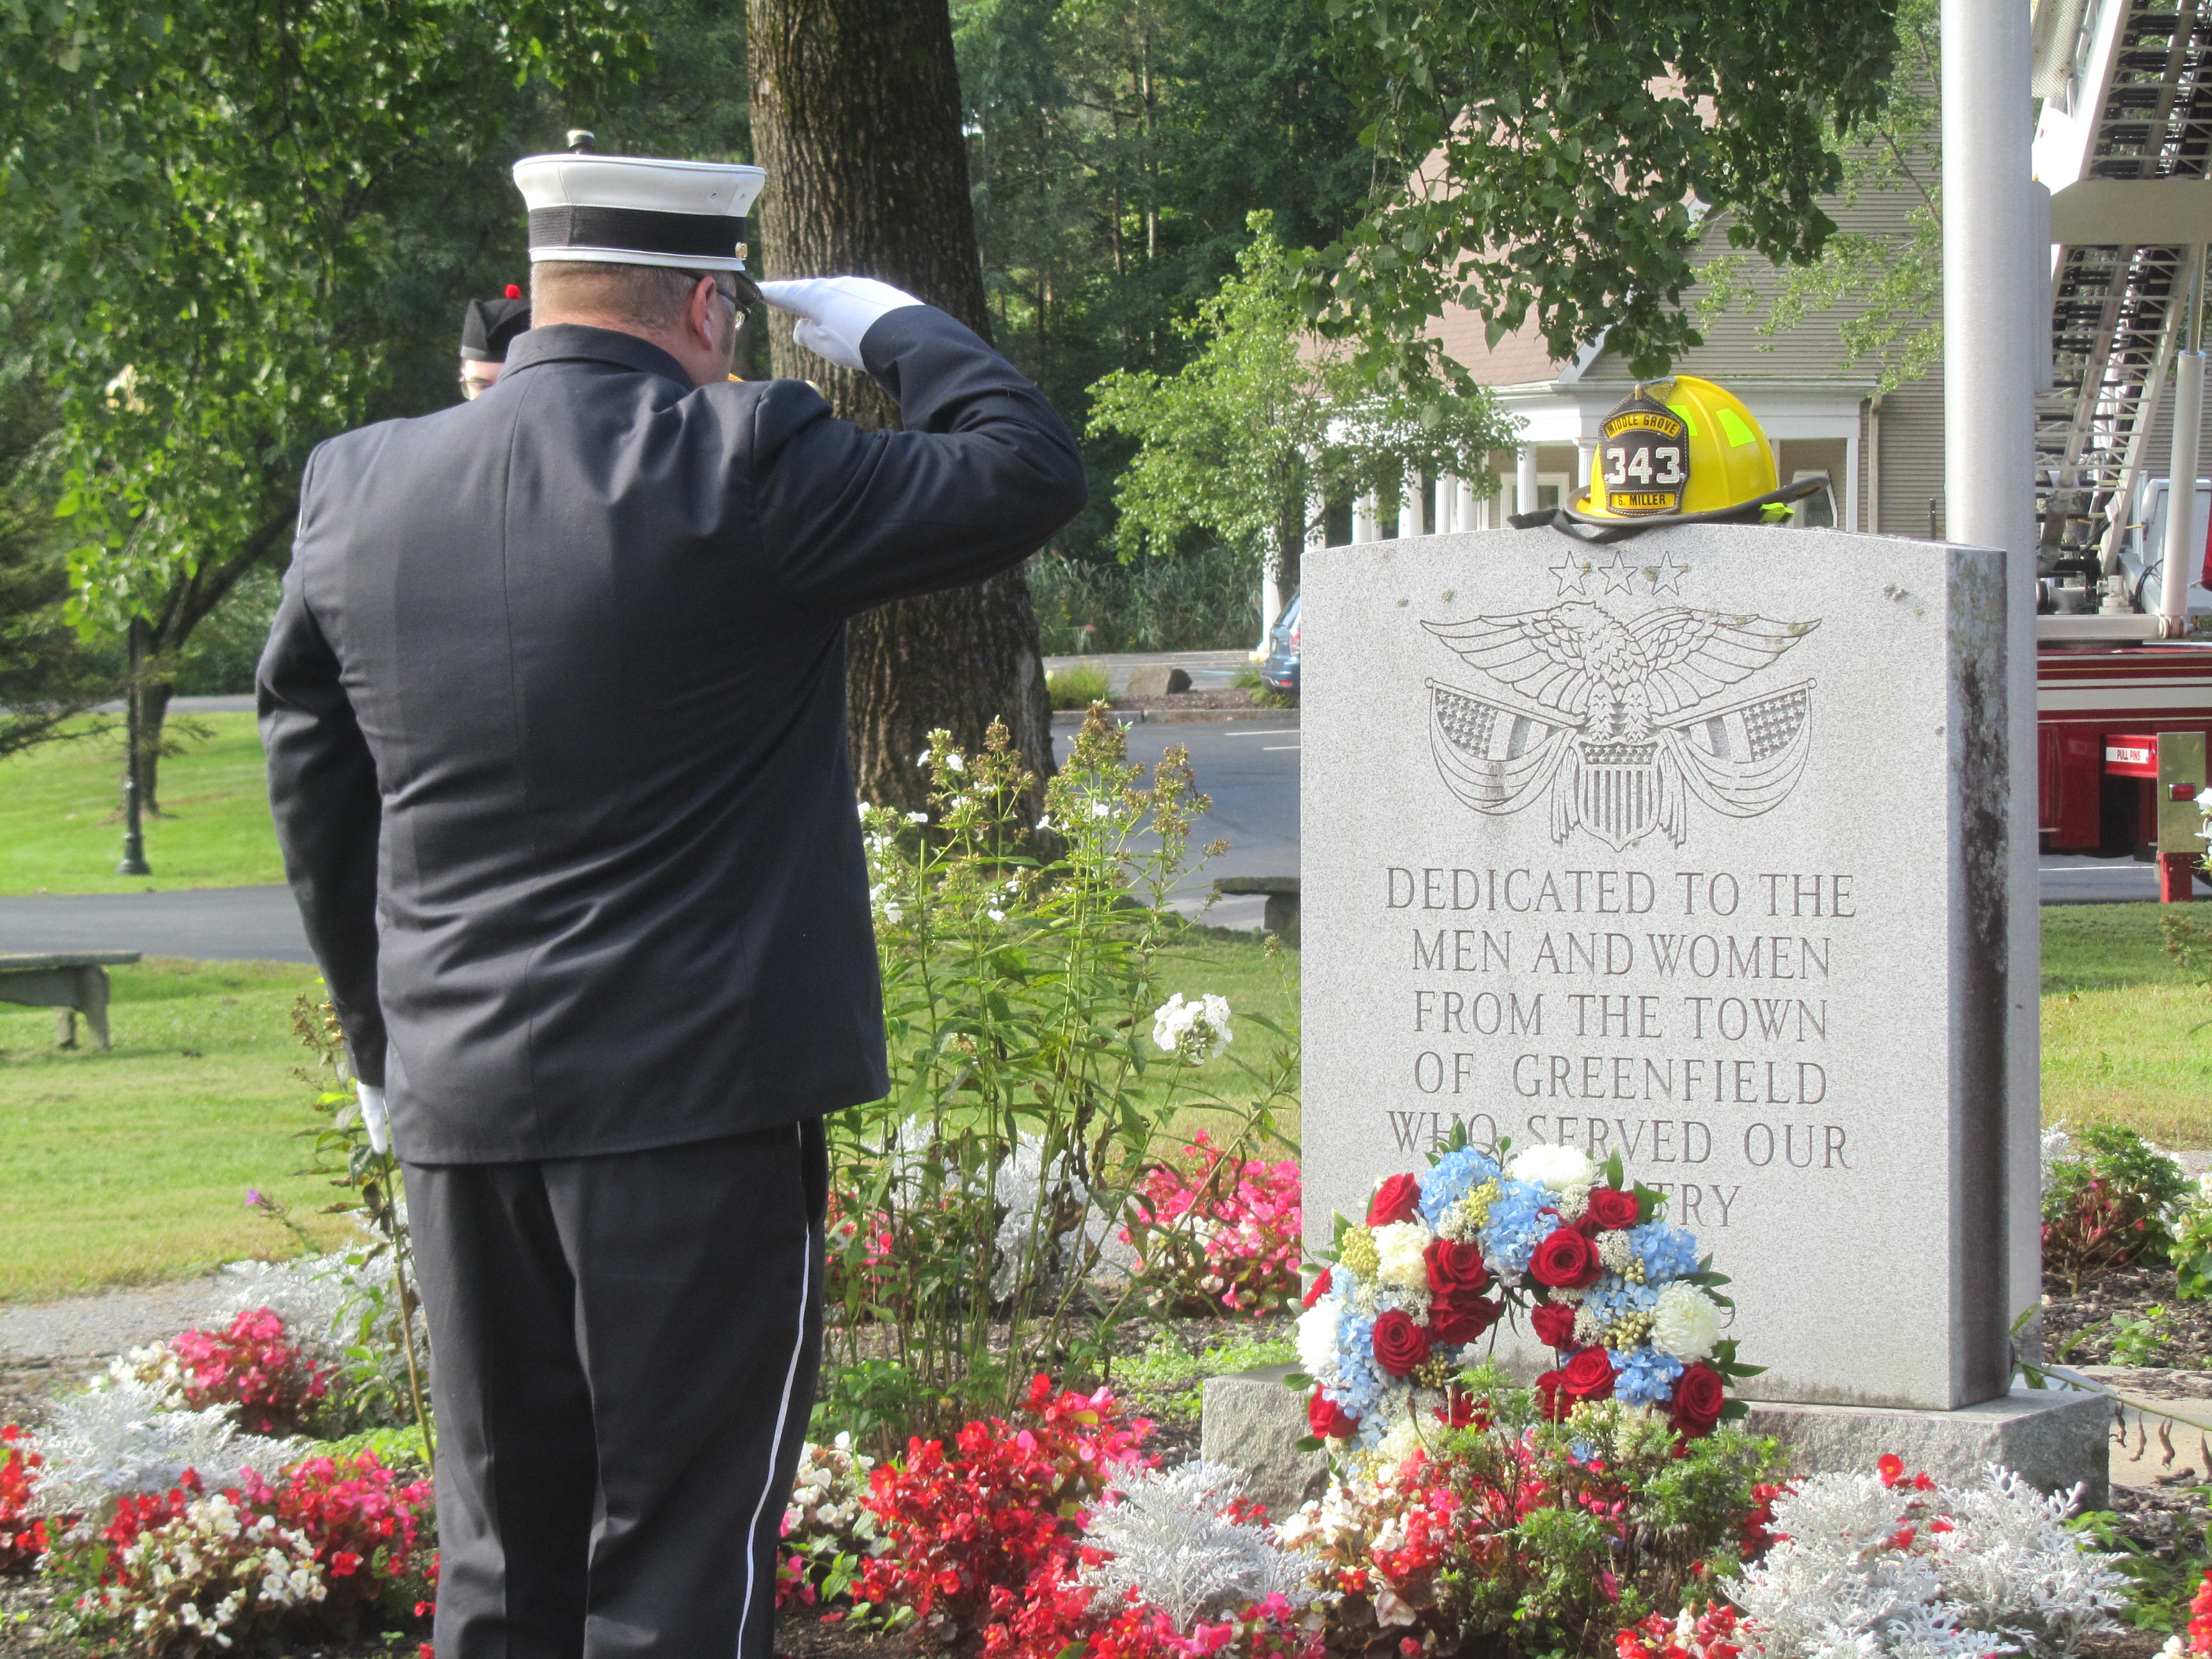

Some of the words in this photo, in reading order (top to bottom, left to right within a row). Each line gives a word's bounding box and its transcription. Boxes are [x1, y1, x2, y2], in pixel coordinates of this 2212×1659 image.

[1607, 416, 1639, 436] MIDDLE
[1643, 415, 1678, 435] GROVE
[1607, 447, 1680, 485] 343
[1630, 493, 1666, 506] MILLER
[2117, 749, 2128, 760] PULL
[2129, 749, 2141, 761] PINS
[1386, 867, 1656, 915] DEDICATED
[1676, 871, 1740, 917] TO
[1759, 873, 1857, 918] THE
[1412, 929, 1512, 972] MEN
[1530, 931, 1634, 975] AND
[1646, 933, 1831, 980] WOMEN
[1414, 990, 1544, 1036] FROM
[1567, 993, 1663, 1038] THE
[1684, 996, 1827, 1043] TOWN
[1414, 1051, 1475, 1094] OF
[1512, 1053, 1827, 1105] GREENFIELD
[1386, 1110, 1497, 1156] WHO
[1743, 1122, 1852, 1169] OUR
